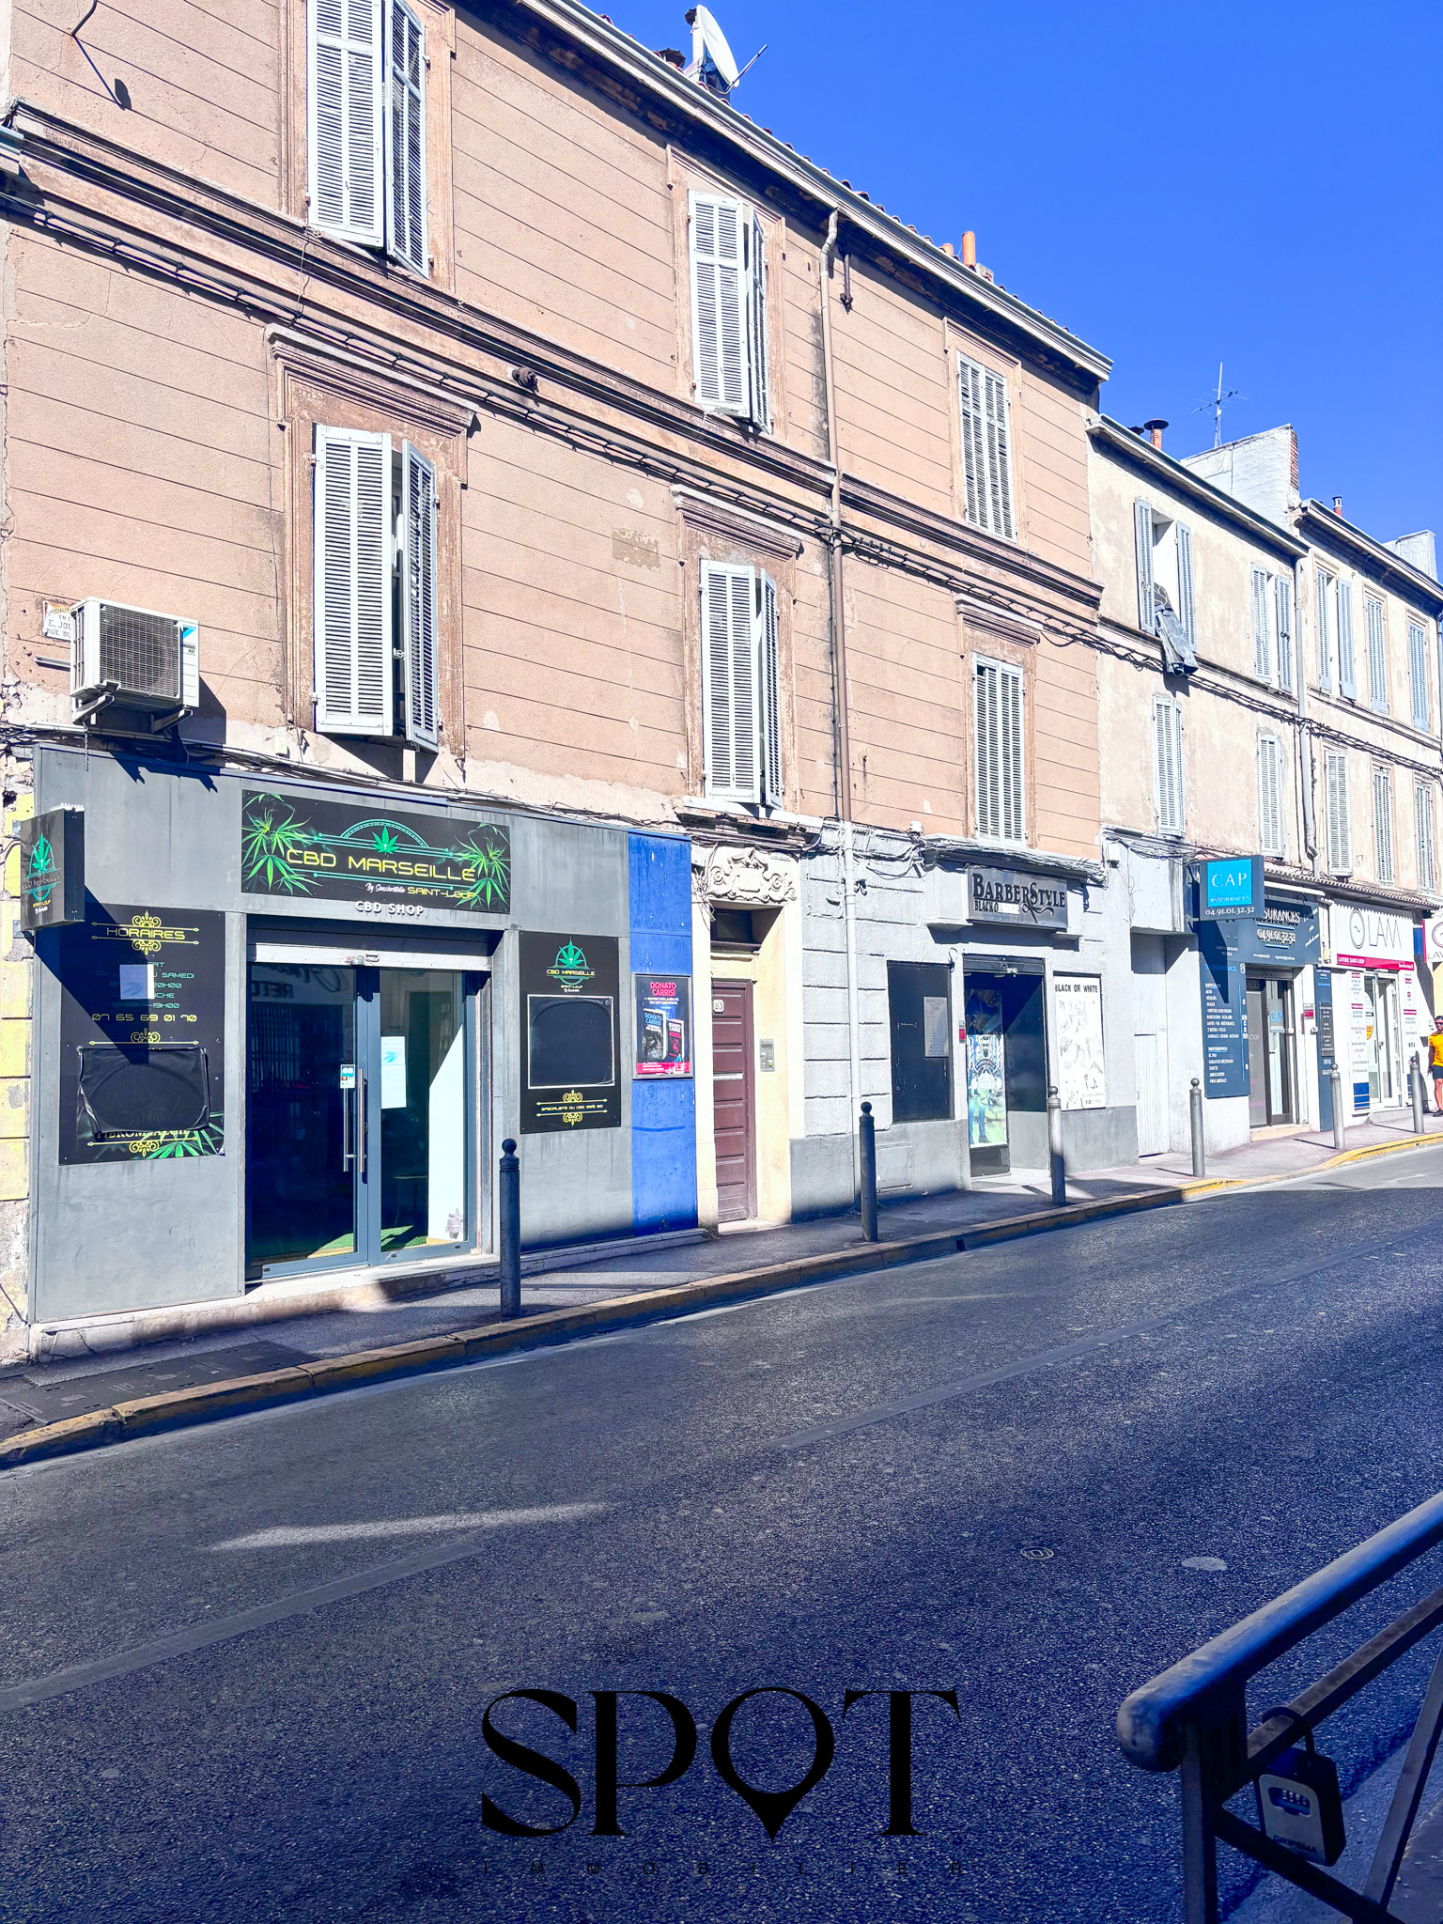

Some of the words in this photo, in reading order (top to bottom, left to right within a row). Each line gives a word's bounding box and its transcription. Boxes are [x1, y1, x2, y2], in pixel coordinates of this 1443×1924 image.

[286, 849, 337, 868] CBD
[348, 855, 477, 883] MARSEILLE
[1211, 872, 1248, 888] CAP
[355, 900, 382, 914] CBD
[388, 903, 424, 917] SHOP
[974, 900, 994, 913] BLACK
[106, 927, 186, 941] HORAIRES
[650, 982, 677, 990] DONATO
[1054, 984, 1072, 993] BLACK
[1073, 984, 1082, 993] OR
[1083, 985, 1098, 994] WHITE
